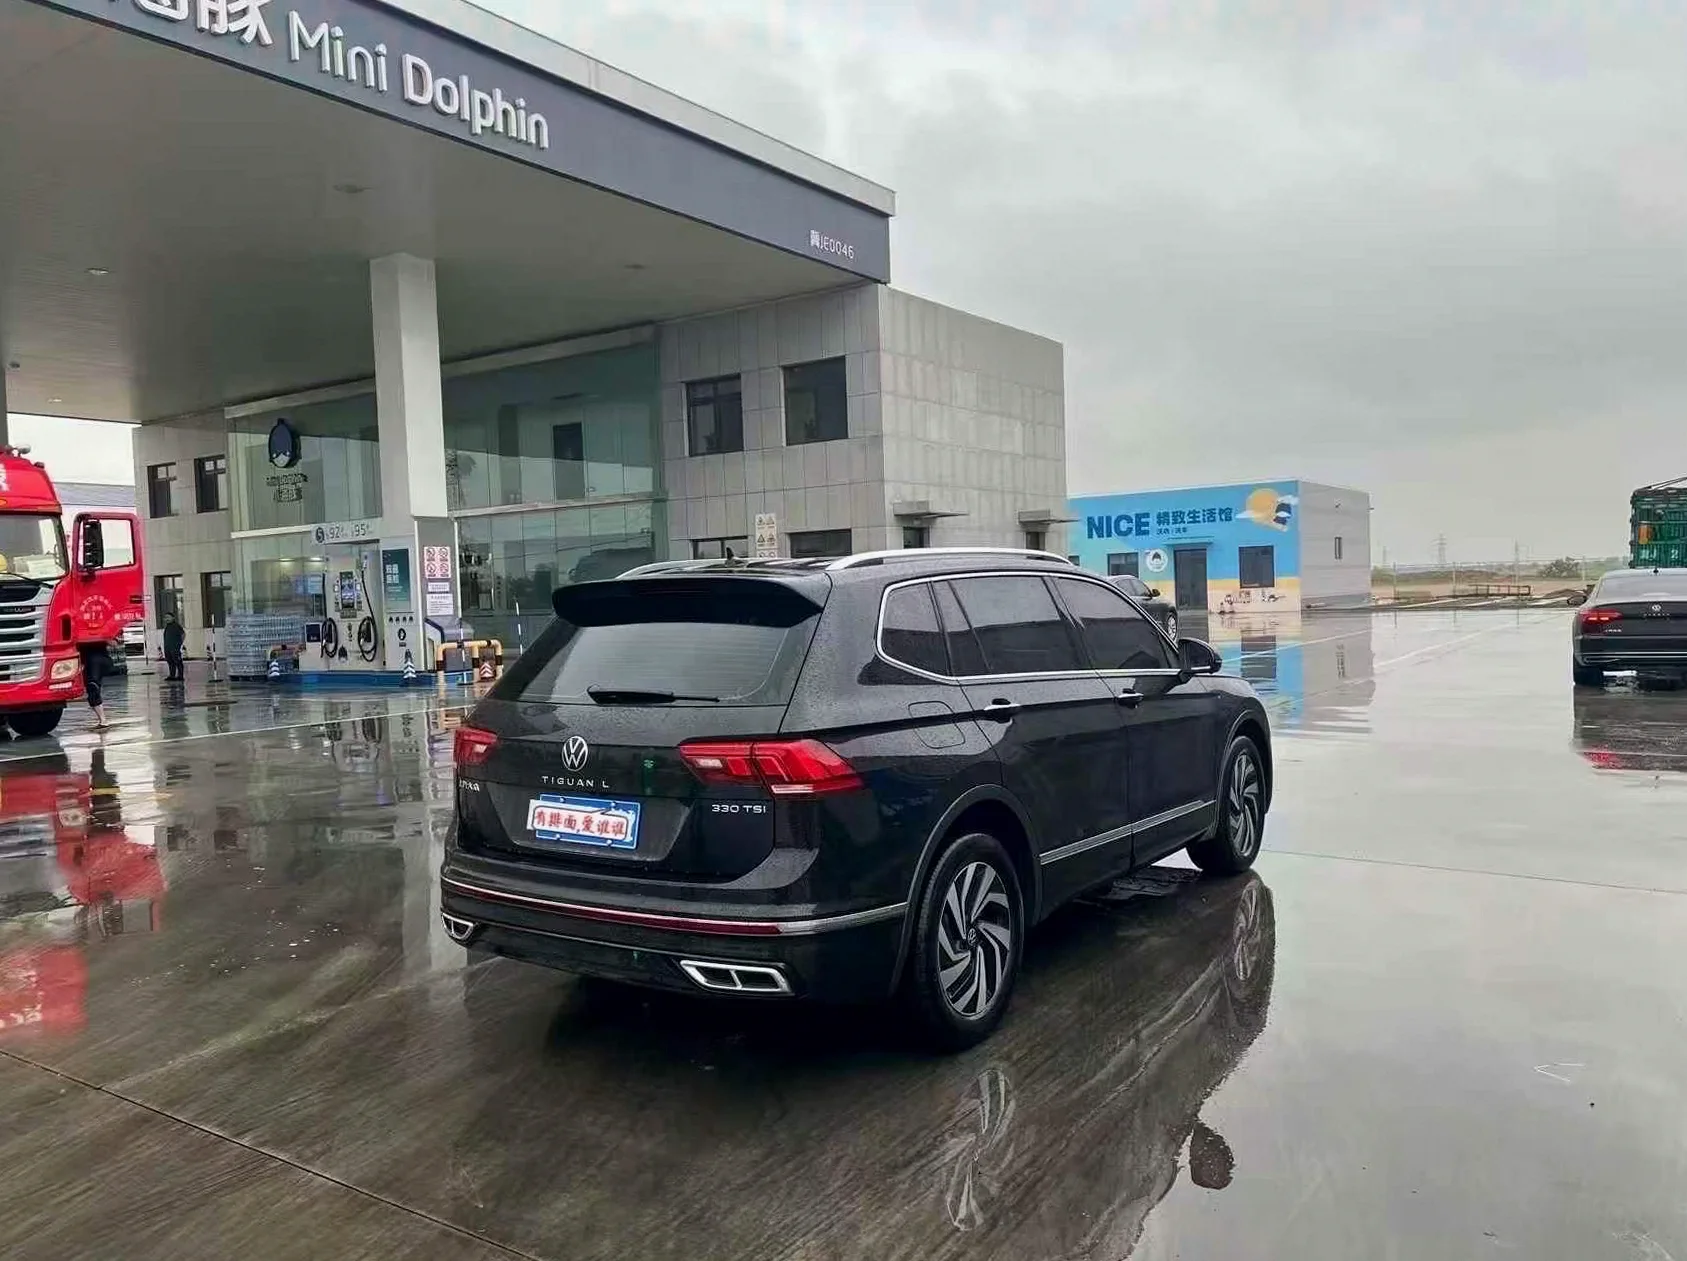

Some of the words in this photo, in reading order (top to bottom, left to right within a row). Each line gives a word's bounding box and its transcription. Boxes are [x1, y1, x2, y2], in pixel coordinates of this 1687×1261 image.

[288, 10, 388, 92] Mini
[402, 53, 550, 149] Dolphin
[1087, 512, 1151, 539] NICE
[541, 775, 595, 788] TIGUAN
[601, 780, 610, 788] L
[711, 804, 740, 813] 330
[742, 805, 767, 814] TSI
